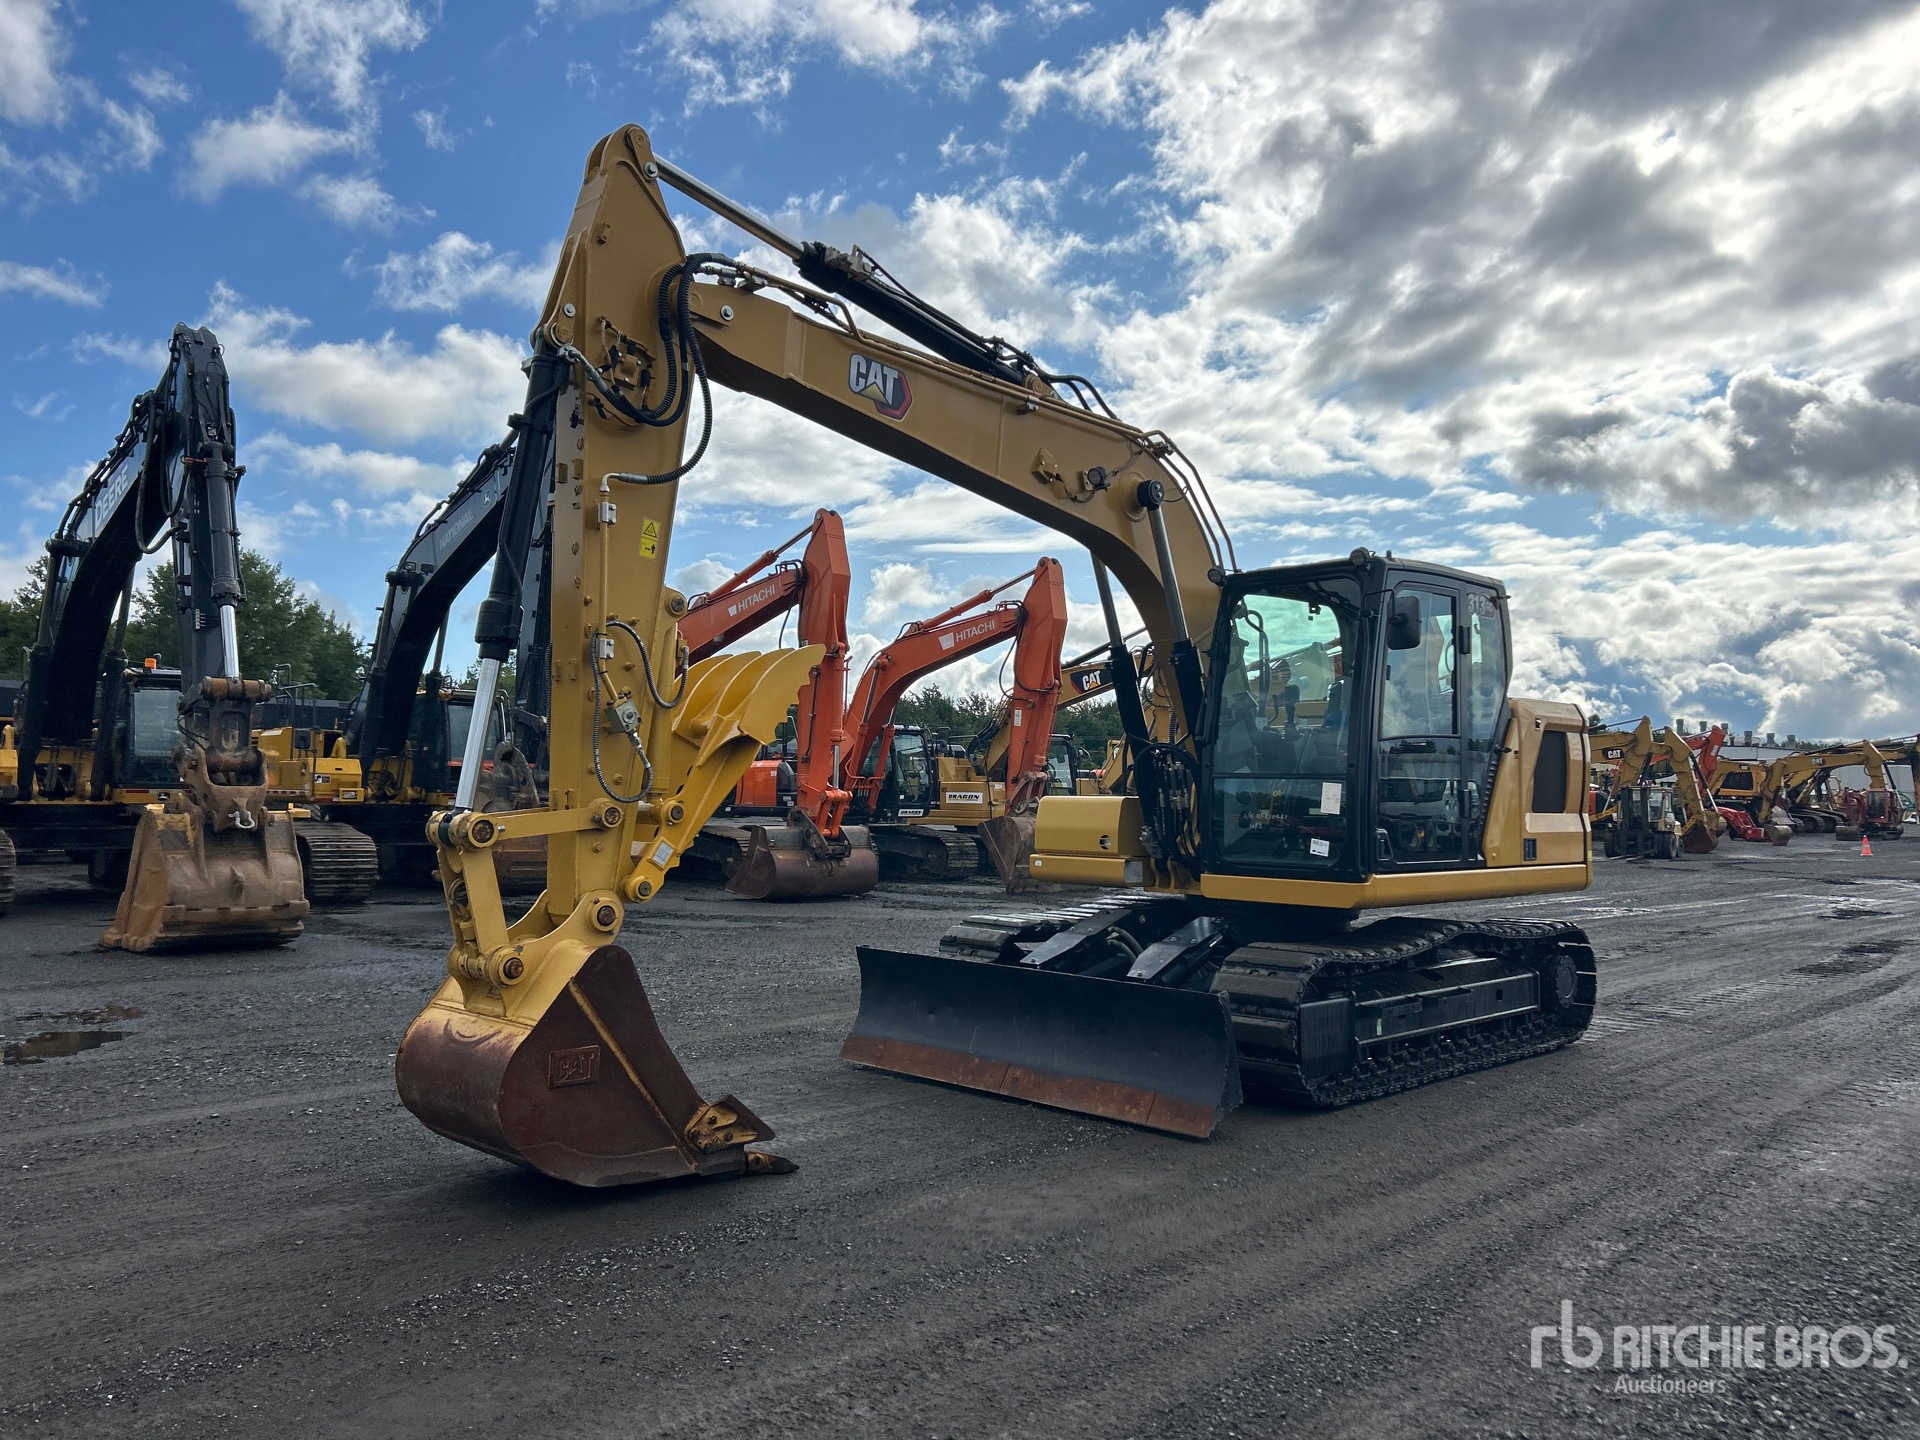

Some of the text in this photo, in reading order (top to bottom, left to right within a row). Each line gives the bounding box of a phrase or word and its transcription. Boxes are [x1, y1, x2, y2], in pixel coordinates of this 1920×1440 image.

[849, 354, 899, 406] CAT
[95, 464, 128, 530] DEERE
[440, 510, 474, 549] NATIONAL
[738, 584, 776, 612] HITACHI
[956, 620, 995, 642] HITACHI
[1082, 670, 1101, 691] CAT
[1607, 749, 1621, 759] CAT
[559, 1053, 595, 1080] CAT
